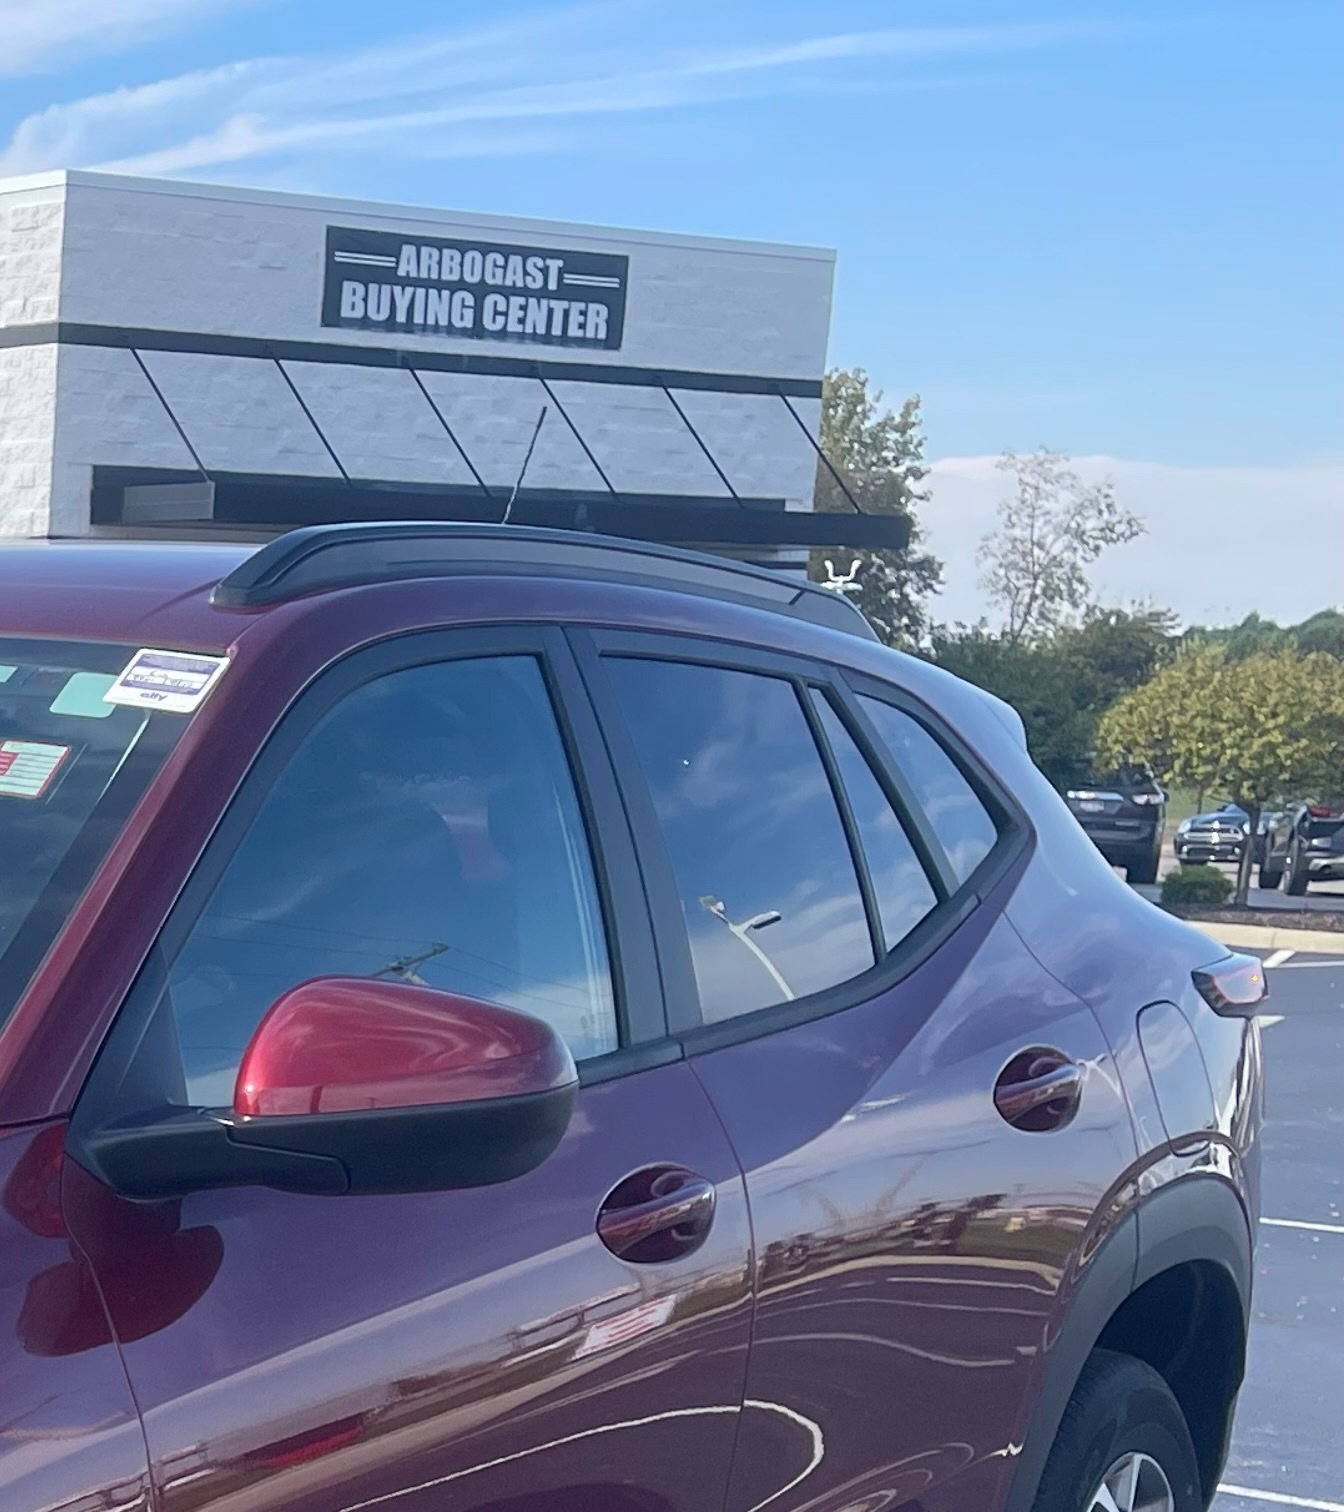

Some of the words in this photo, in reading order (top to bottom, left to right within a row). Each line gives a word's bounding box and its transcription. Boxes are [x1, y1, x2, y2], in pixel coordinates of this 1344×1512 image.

[397, 243, 564, 291] ARBOGAST
[340, 280, 475, 329] BUYING
[482, 293, 609, 341] CENTER
